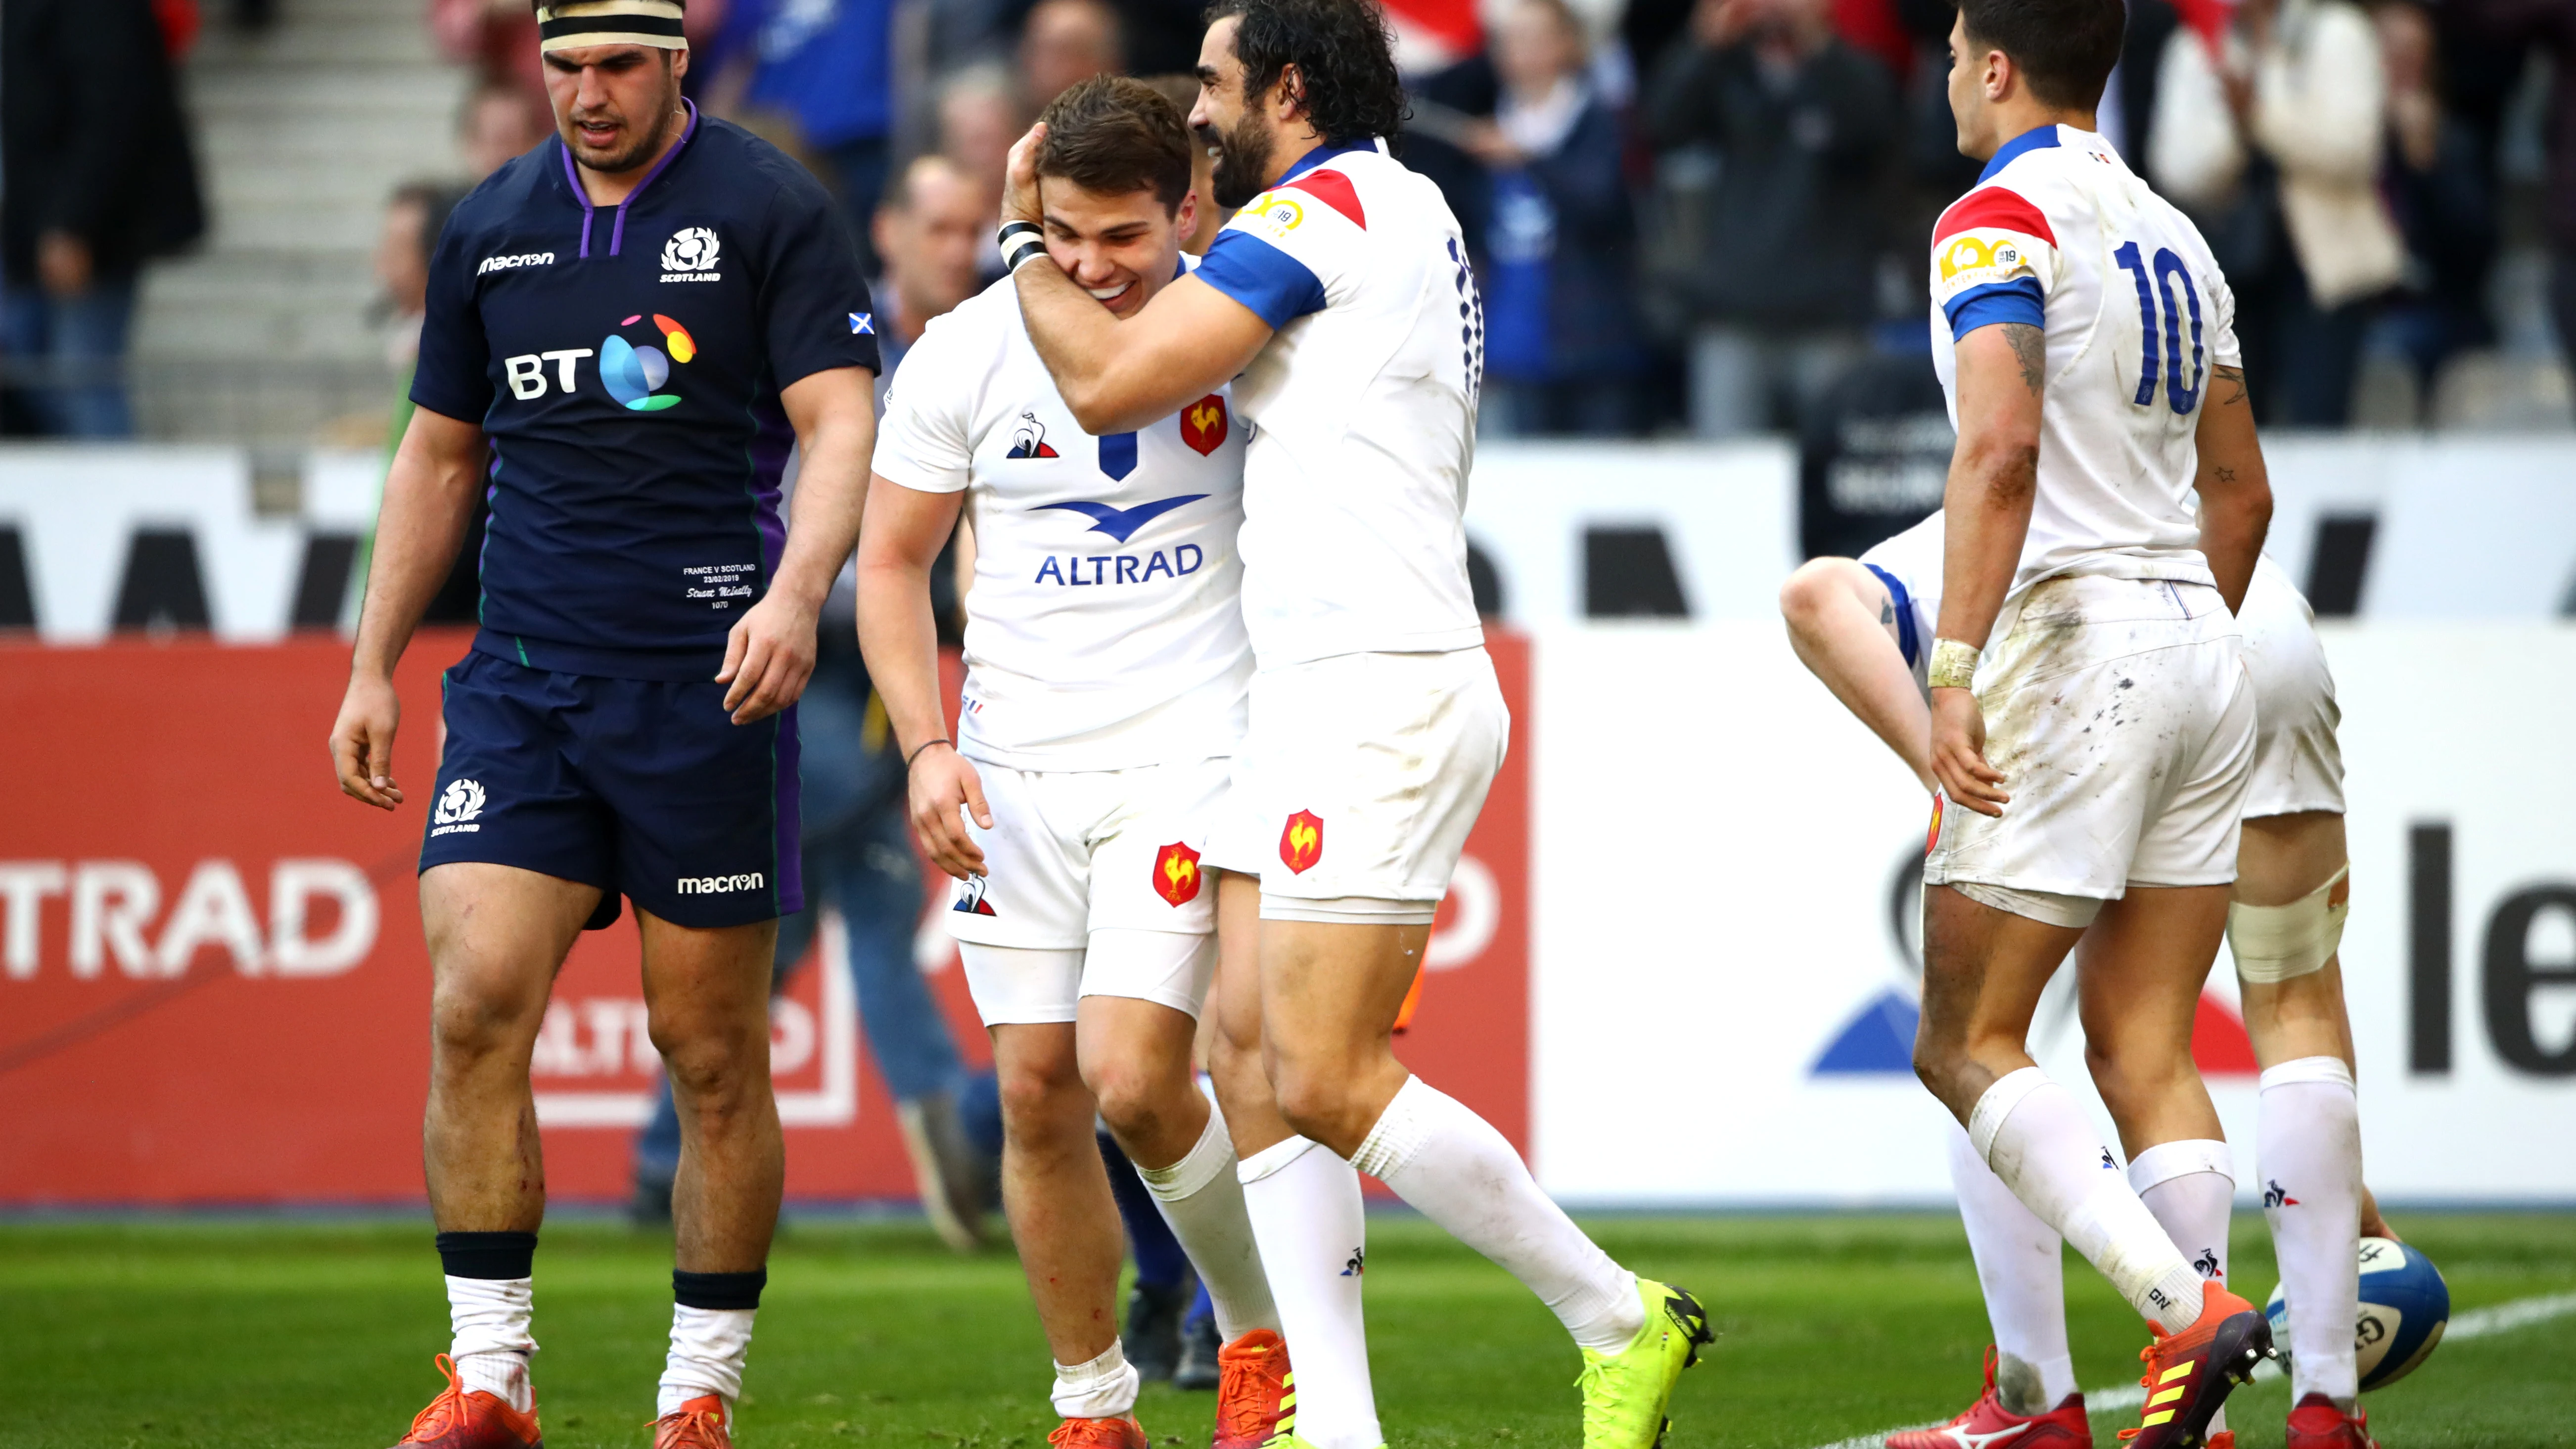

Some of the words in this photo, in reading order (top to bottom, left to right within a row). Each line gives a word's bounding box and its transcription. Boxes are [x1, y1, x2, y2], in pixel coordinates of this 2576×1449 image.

[477, 252, 554, 276] macron
[659, 273, 721, 282] SCOTLAND
[2114, 241, 2204, 415] 10
[505, 348, 594, 401] BT
[683, 566, 713, 575] FRANCE
[721, 564, 756, 573] SCOTLAND
[1035, 543, 1203, 586] ALTRAD
[703, 574, 739, 583] 23/02/2019
[686, 588, 716, 598] Stuart
[712, 601, 729, 609] 1070
[431, 824, 480, 838] SCOTLAND
[678, 872, 764, 894] macron
[2149, 1288, 2171, 1311] GN
